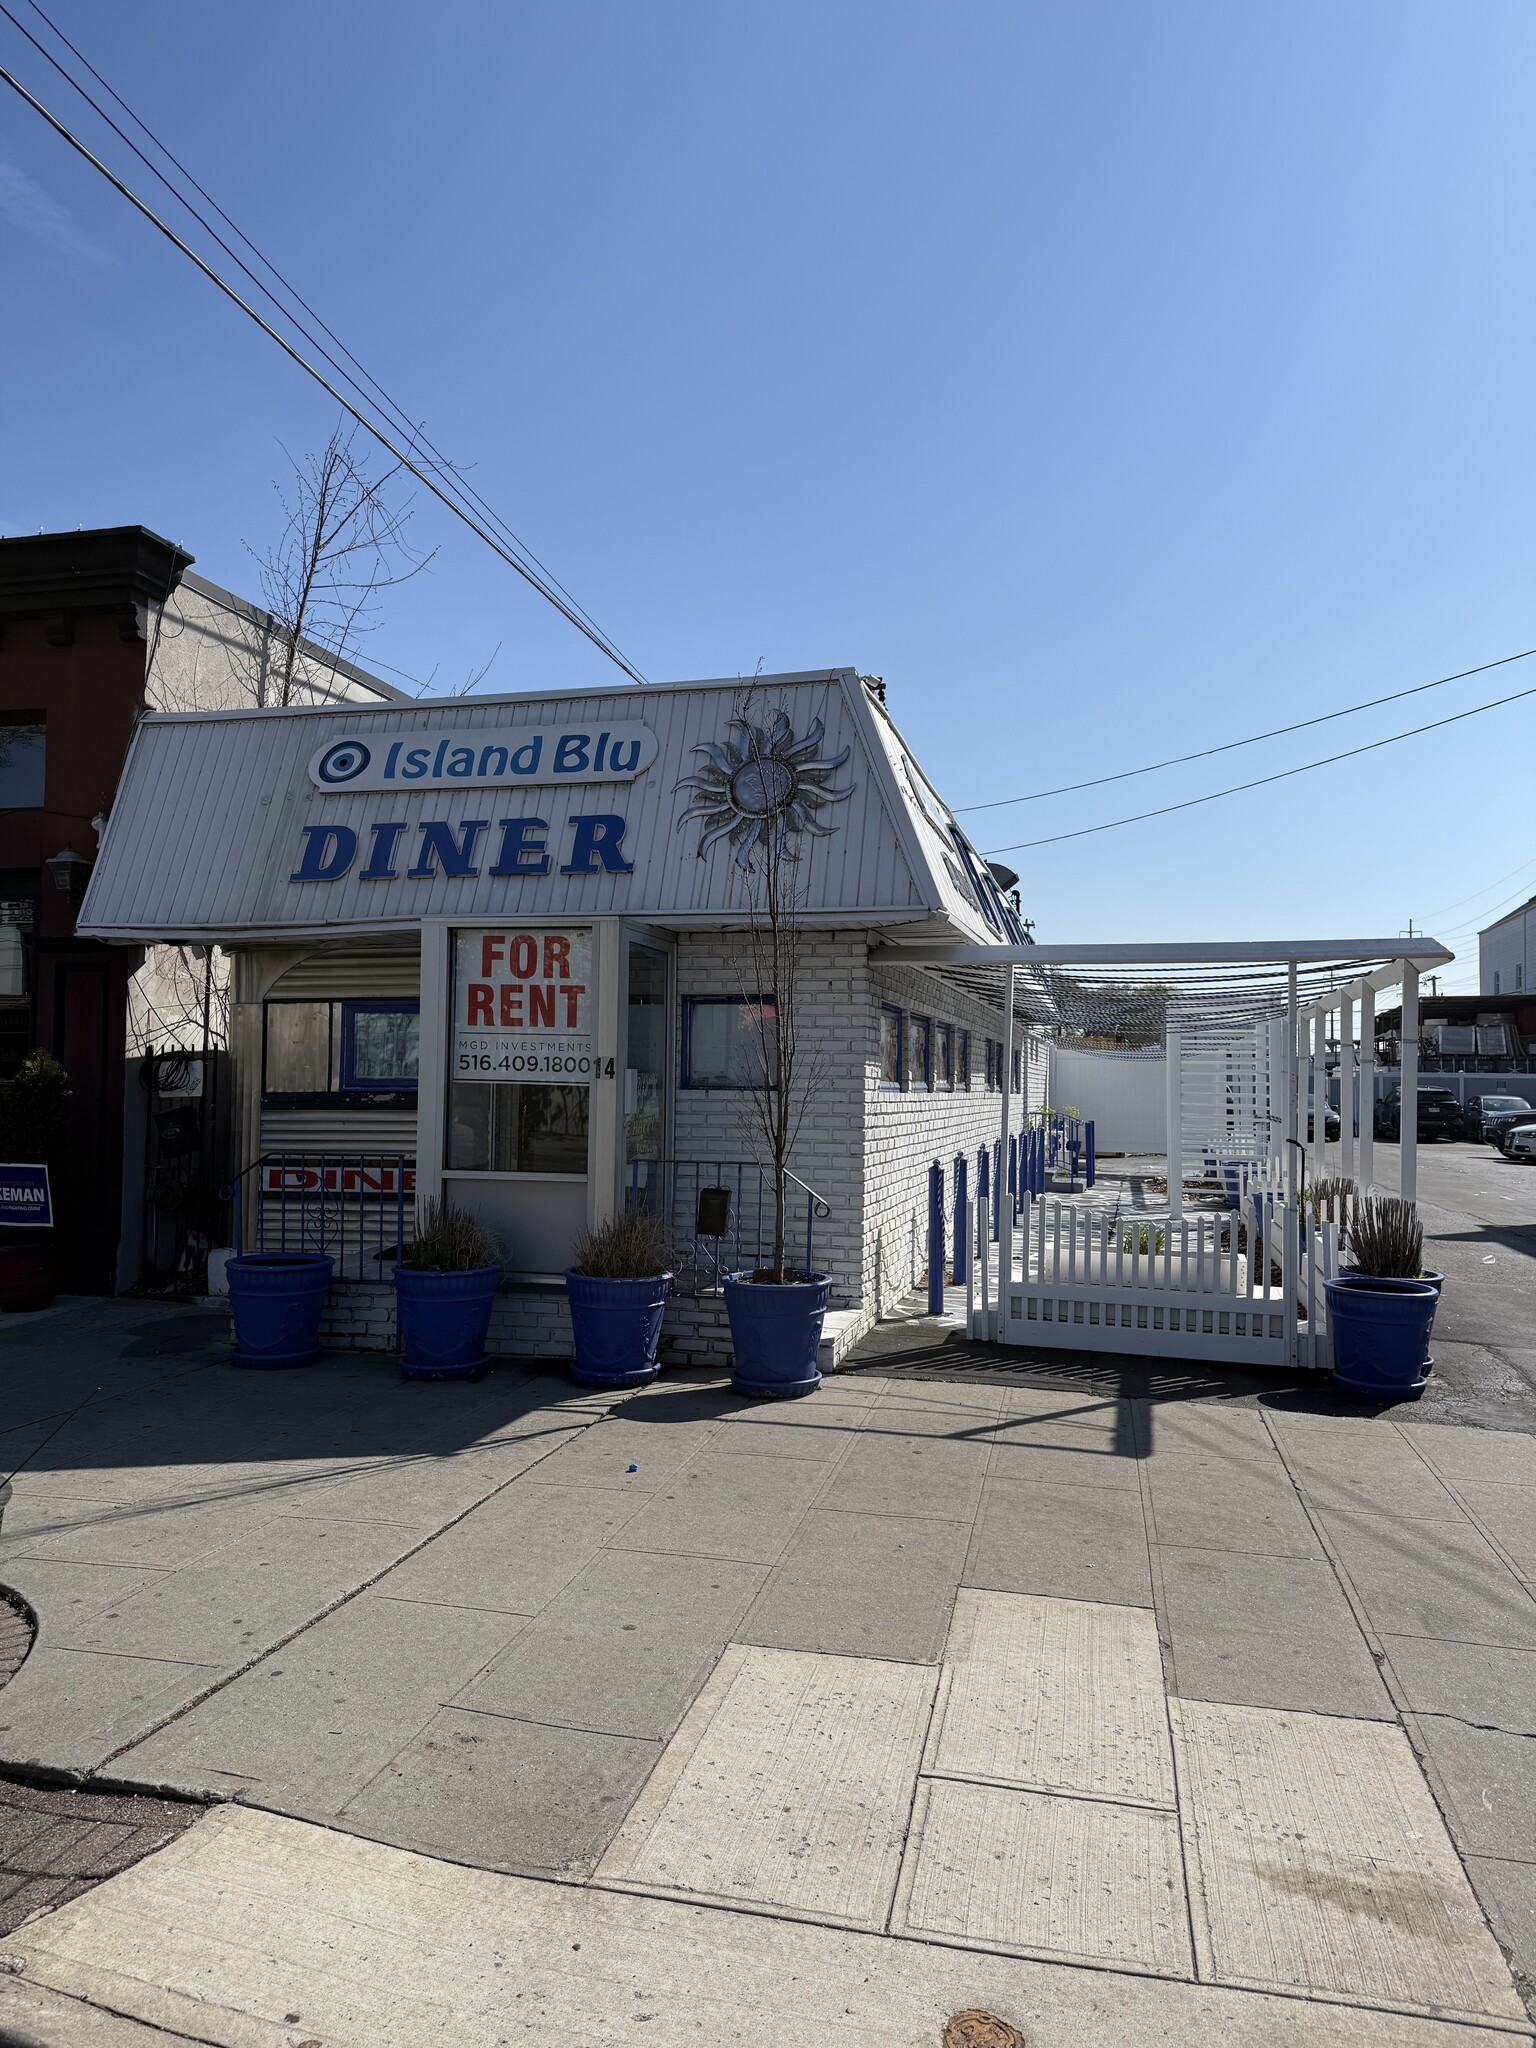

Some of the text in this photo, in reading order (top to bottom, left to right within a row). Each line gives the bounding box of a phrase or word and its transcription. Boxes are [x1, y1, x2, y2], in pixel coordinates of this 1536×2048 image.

[384, 732, 641, 779] Island Blu
[289, 814, 635, 883] DINER
[481, 934, 572, 979] FOR
[467, 983, 586, 1028] RENT
[459, 1040, 591, 1052] MGD INVESTMENTS
[459, 1054, 591, 1073] 516.409.1800
[593, 1057, 616, 1079] 14
